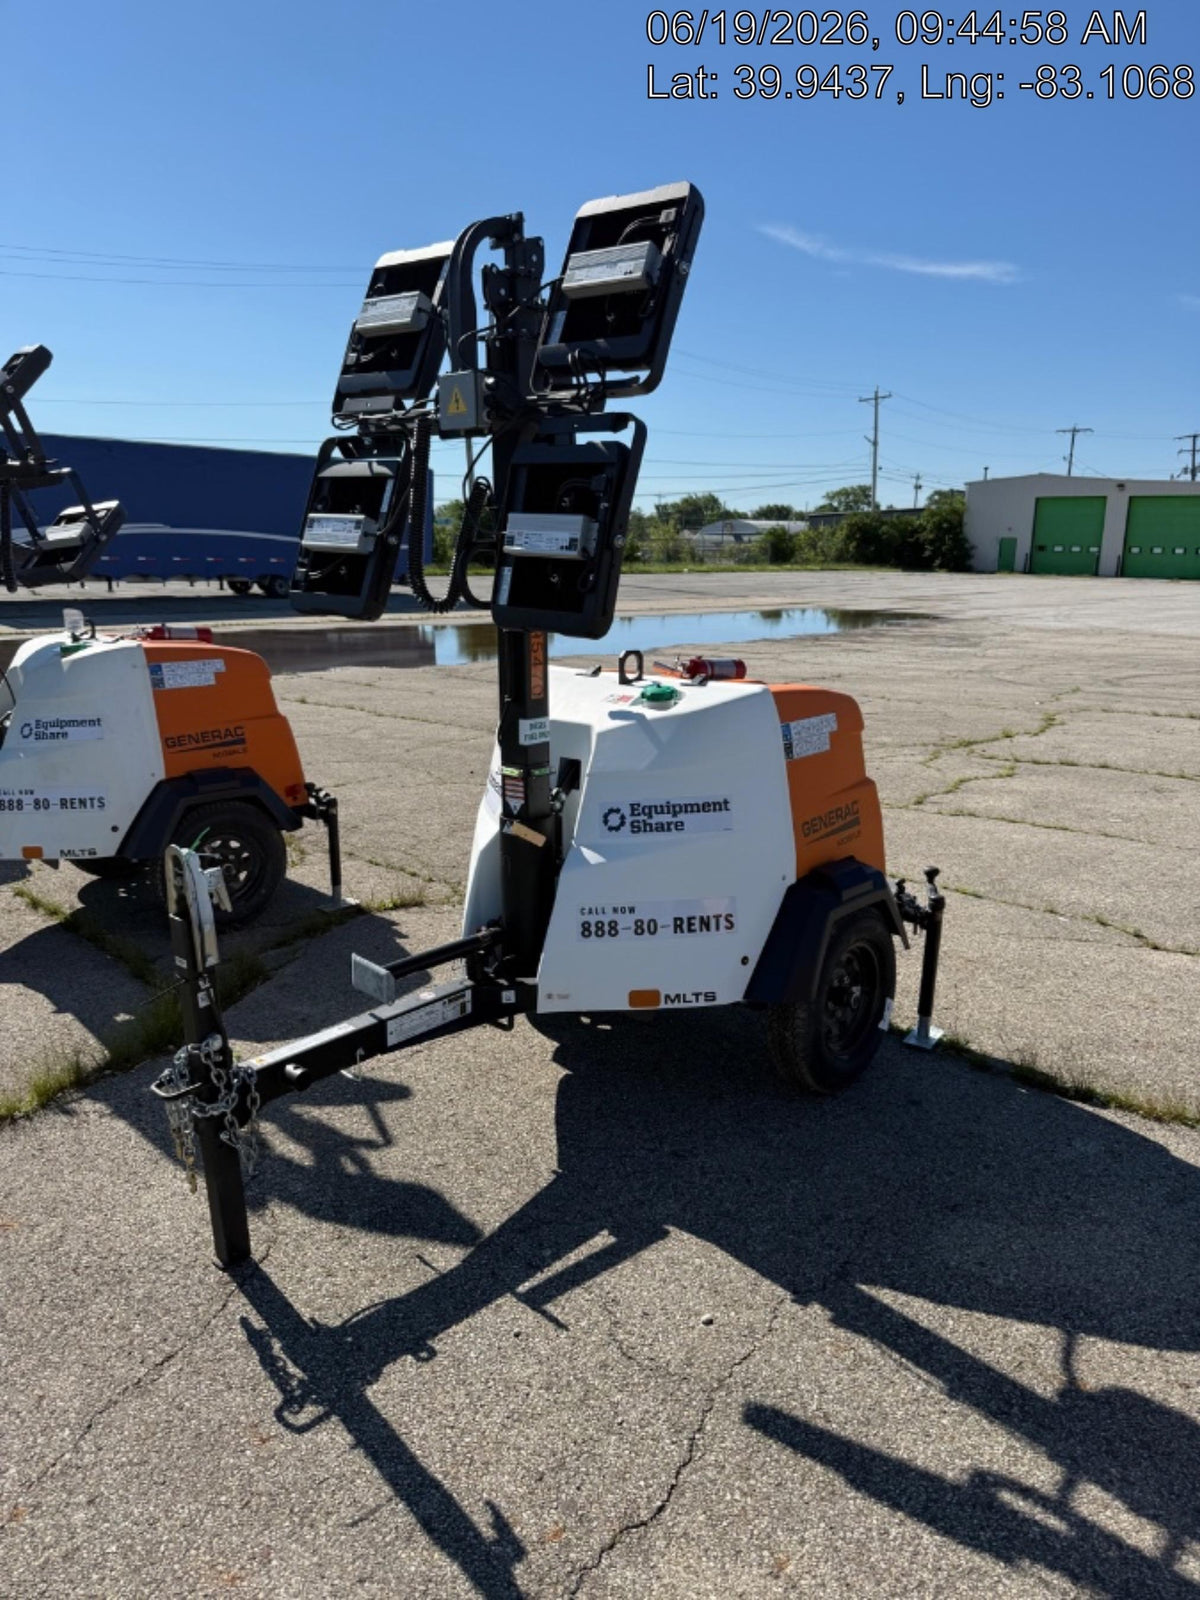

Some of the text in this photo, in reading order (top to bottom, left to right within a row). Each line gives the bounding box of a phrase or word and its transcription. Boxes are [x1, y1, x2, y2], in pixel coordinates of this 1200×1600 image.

[34, 717, 102, 731] Equipment
[34, 731, 69, 741] Share
[165, 726, 245, 748] GENERAC
[629, 798, 731, 819] Equipment
[630, 819, 685, 834] Share
[801, 800, 859, 838] GENERAC
[580, 906, 636, 916] CALL NOW
[580, 913, 735, 938] 888-80-RENTS
[664, 991, 717, 1005] MLTS
